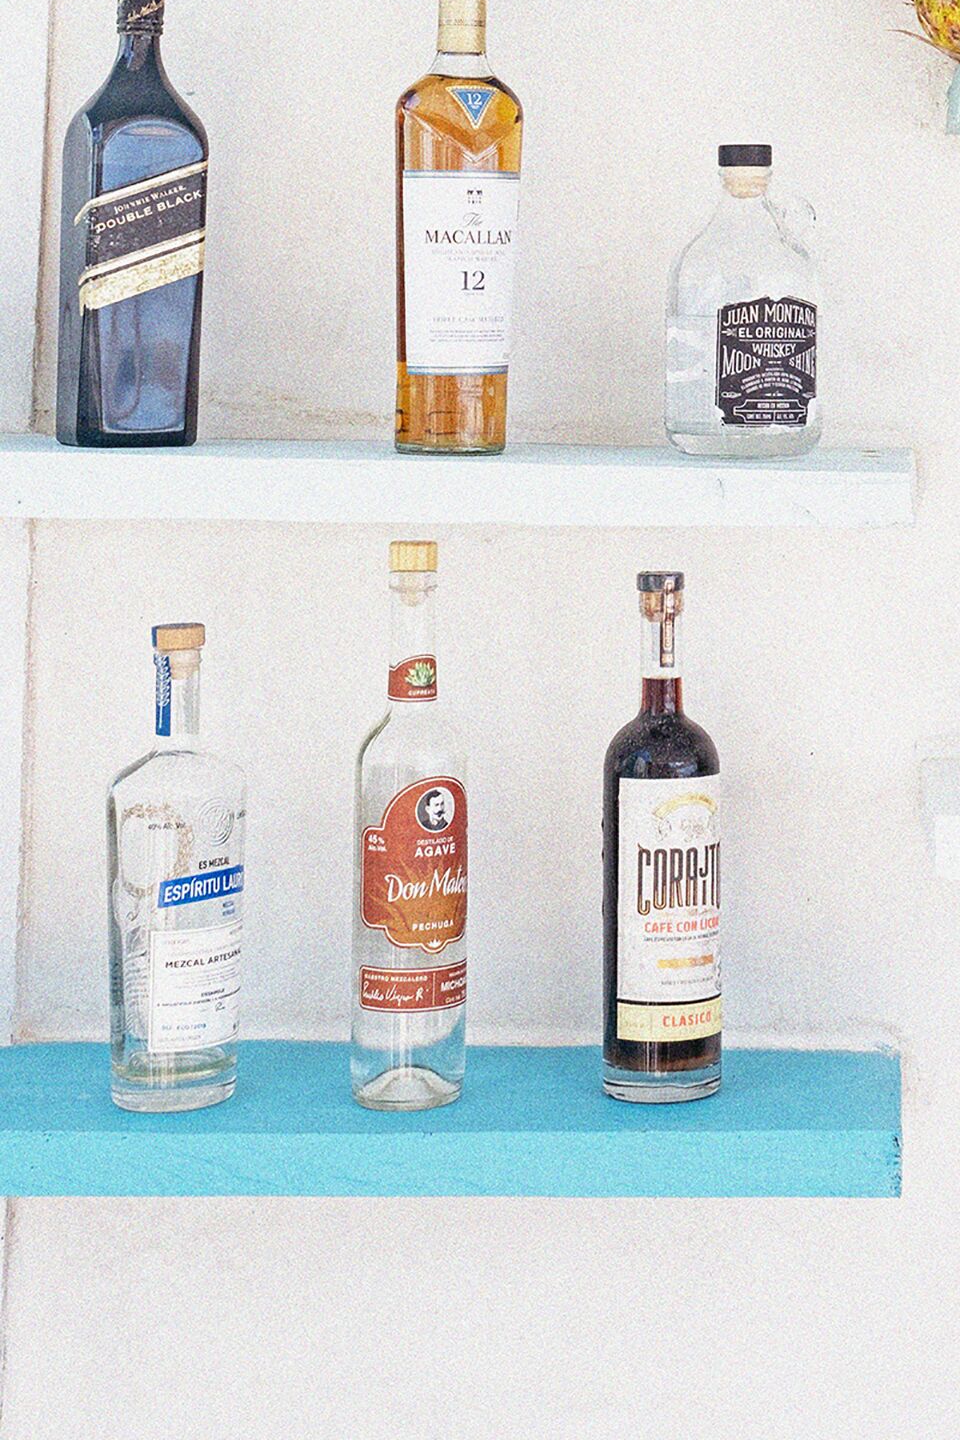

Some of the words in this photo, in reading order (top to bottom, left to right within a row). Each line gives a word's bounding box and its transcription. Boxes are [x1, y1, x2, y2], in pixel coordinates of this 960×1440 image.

[467, 93, 482, 106] 12
[95, 206, 153, 234] DOUBLE
[157, 189, 203, 212] BLACK
[463, 212, 483, 227] The
[425, 229, 512, 245] MACALLAN
[460, 270, 485, 291] 12
[723, 304, 760, 326] JUAN
[739, 327, 752, 338] EL
[755, 326, 807, 339] ORIGINAL
[752, 343, 797, 358] WHISKEY
[721, 345, 761, 379] MOON
[414, 843, 456, 858] AGAVE
[199, 861, 208, 870] ES
[209, 857, 230, 867] MEZCAL
[163, 877, 220, 903] ESPÍRITU
[384, 874, 429, 903] Don
[412, 920, 454, 931] PECHUGA
[644, 922, 673, 933] CAFE
[676, 921, 697, 933] CON
[165, 959, 205, 968] MEZCAL
